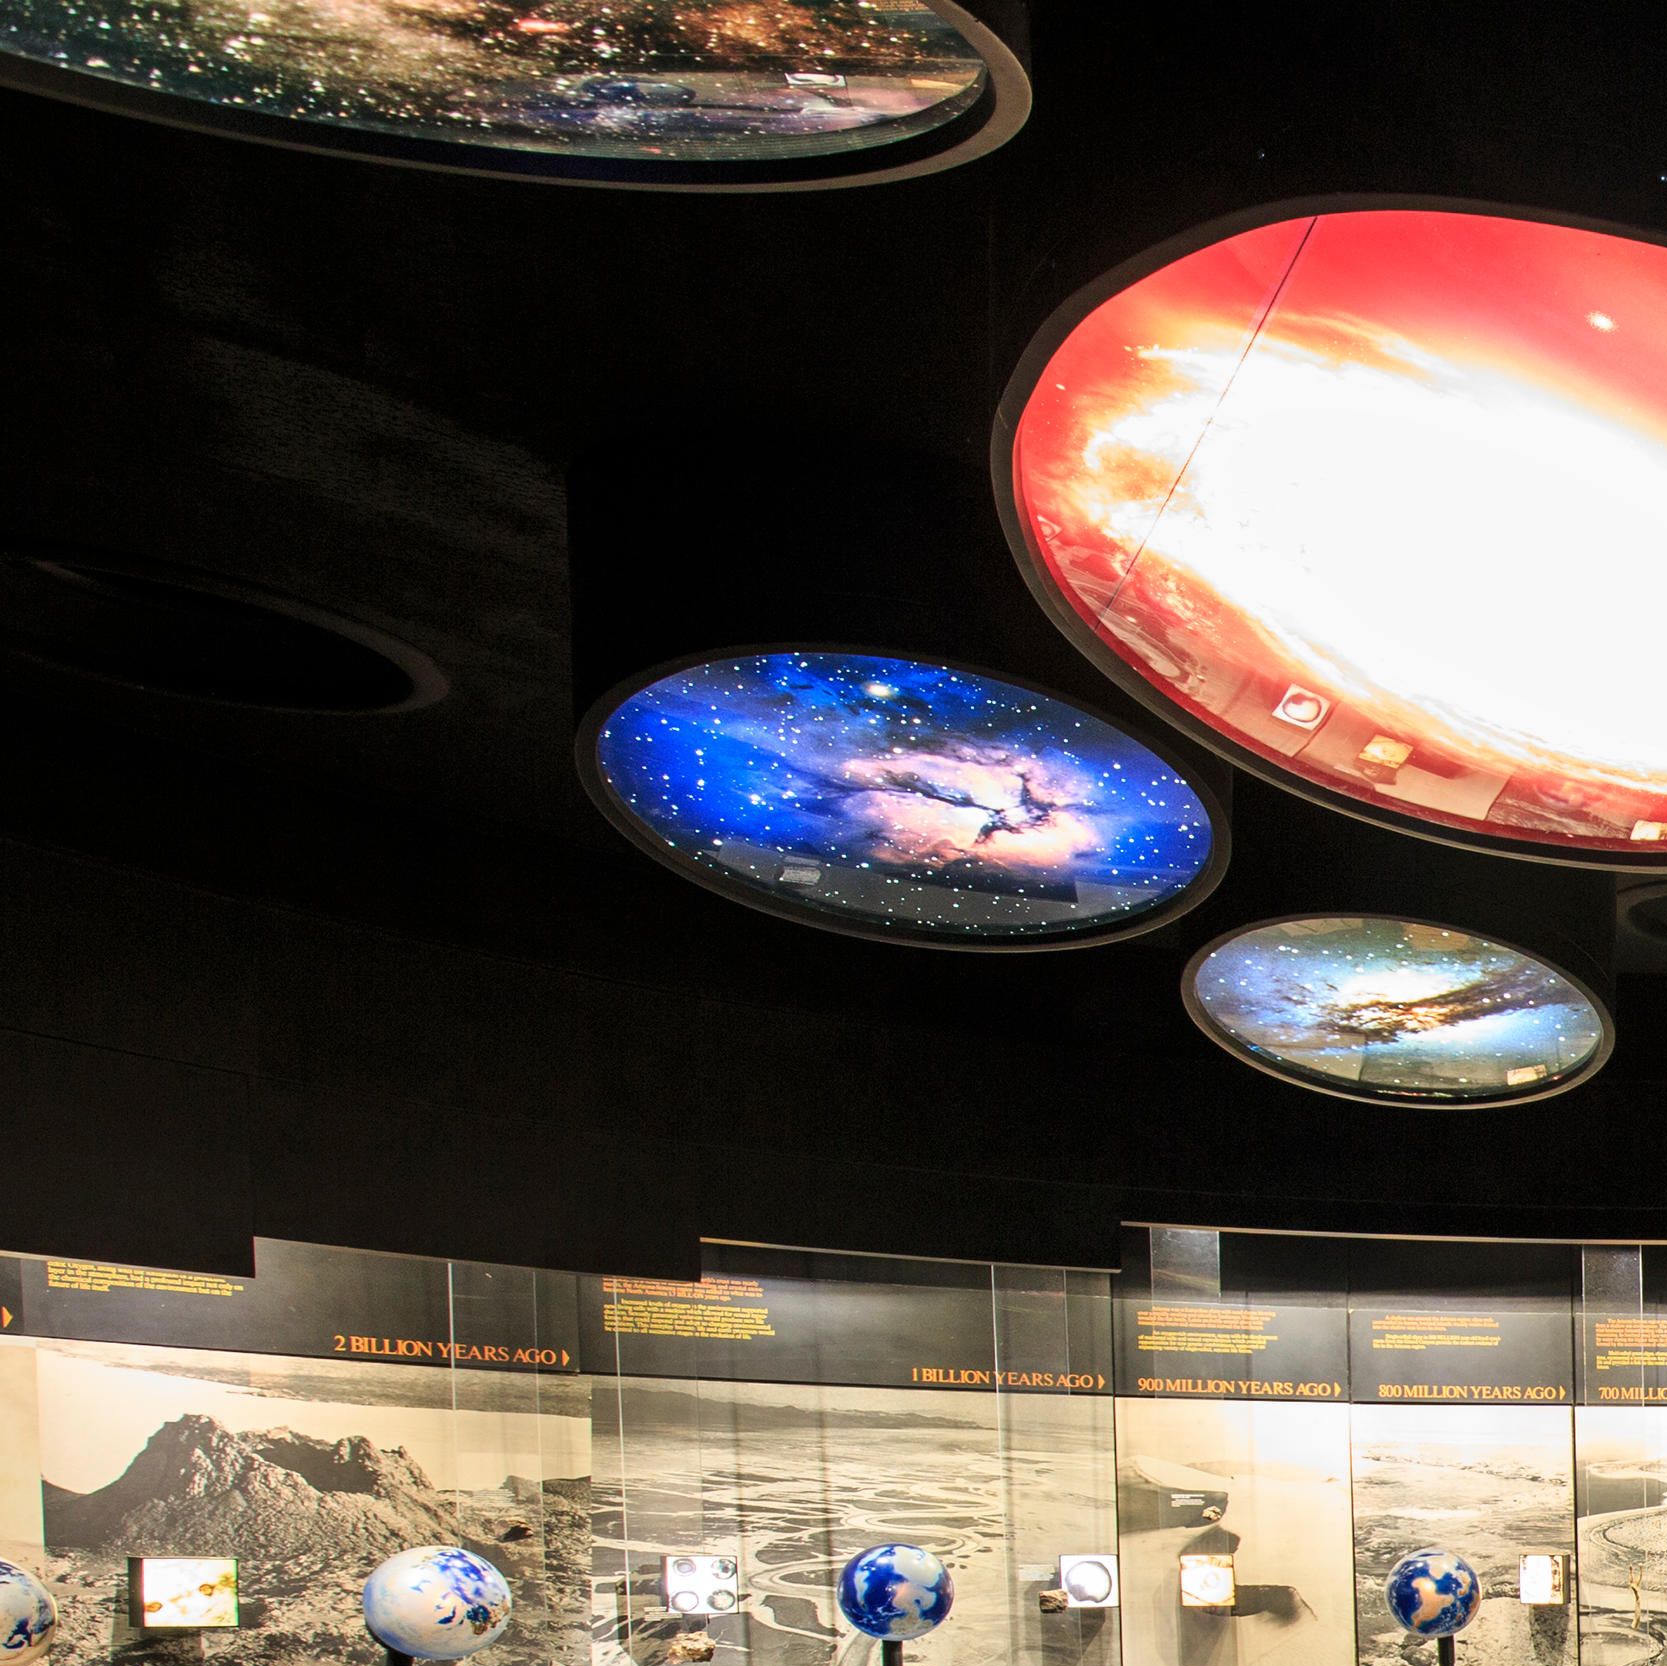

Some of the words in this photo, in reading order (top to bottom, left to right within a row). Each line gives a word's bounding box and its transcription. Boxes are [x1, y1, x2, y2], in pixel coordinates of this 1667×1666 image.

[350, 1336, 432, 1357] BILLION
[437, 1343, 510, 1362] YEARS
[513, 1348, 557, 1365] AGO
[922, 1368, 990, 1384] BILLION
[996, 1372, 1054, 1386] YEARS
[1057, 1374, 1094, 1388] AGO
[1137, 1377, 1163, 1391] 900
[1166, 1378, 1235, 1394] MILLION
[1238, 1381, 1294, 1396] YEARS
[1296, 1382, 1332, 1397] AGO
[1378, 1385, 1401, 1398] 800
[1402, 1385, 1467, 1399] MILLION
[1469, 1386, 1521, 1400] YEARS
[1523, 1386, 1557, 1400] AGO
[1598, 1387, 1619, 1400] 700
